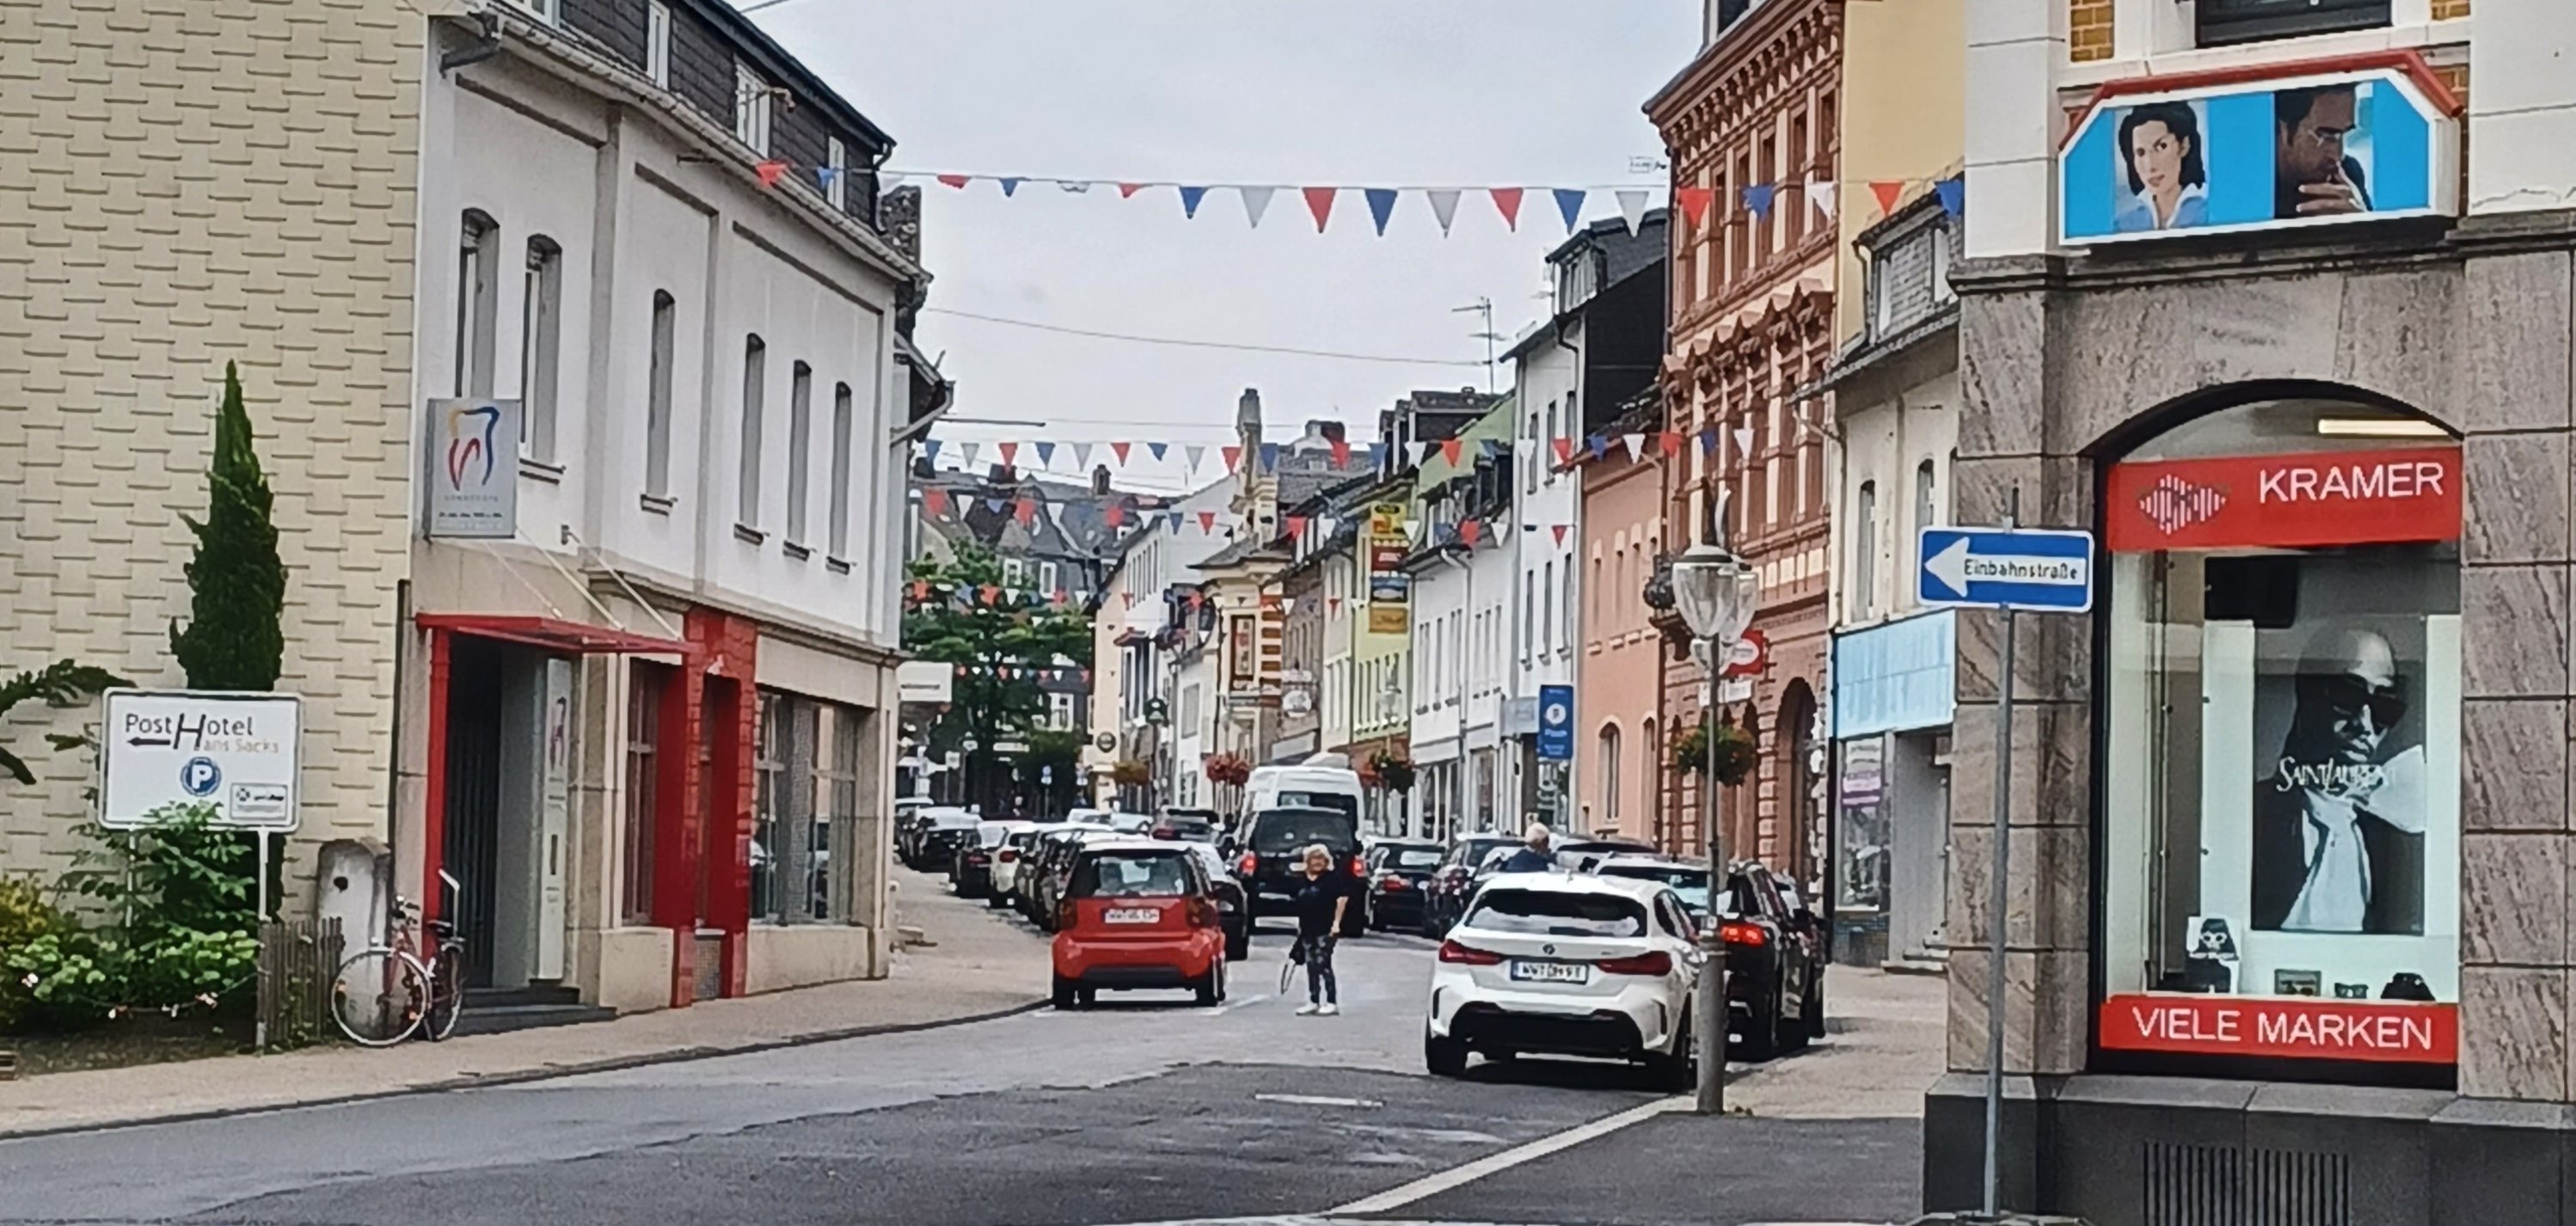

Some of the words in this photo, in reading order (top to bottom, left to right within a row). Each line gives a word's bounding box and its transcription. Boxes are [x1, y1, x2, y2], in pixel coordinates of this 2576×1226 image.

[2260, 462, 2444, 504] KRAMER
[1965, 559, 2077, 579] Einbahnstraße
[2132, 1007, 2242, 1043] VIELE
[2258, 1011, 2432, 1050] MARKEN
